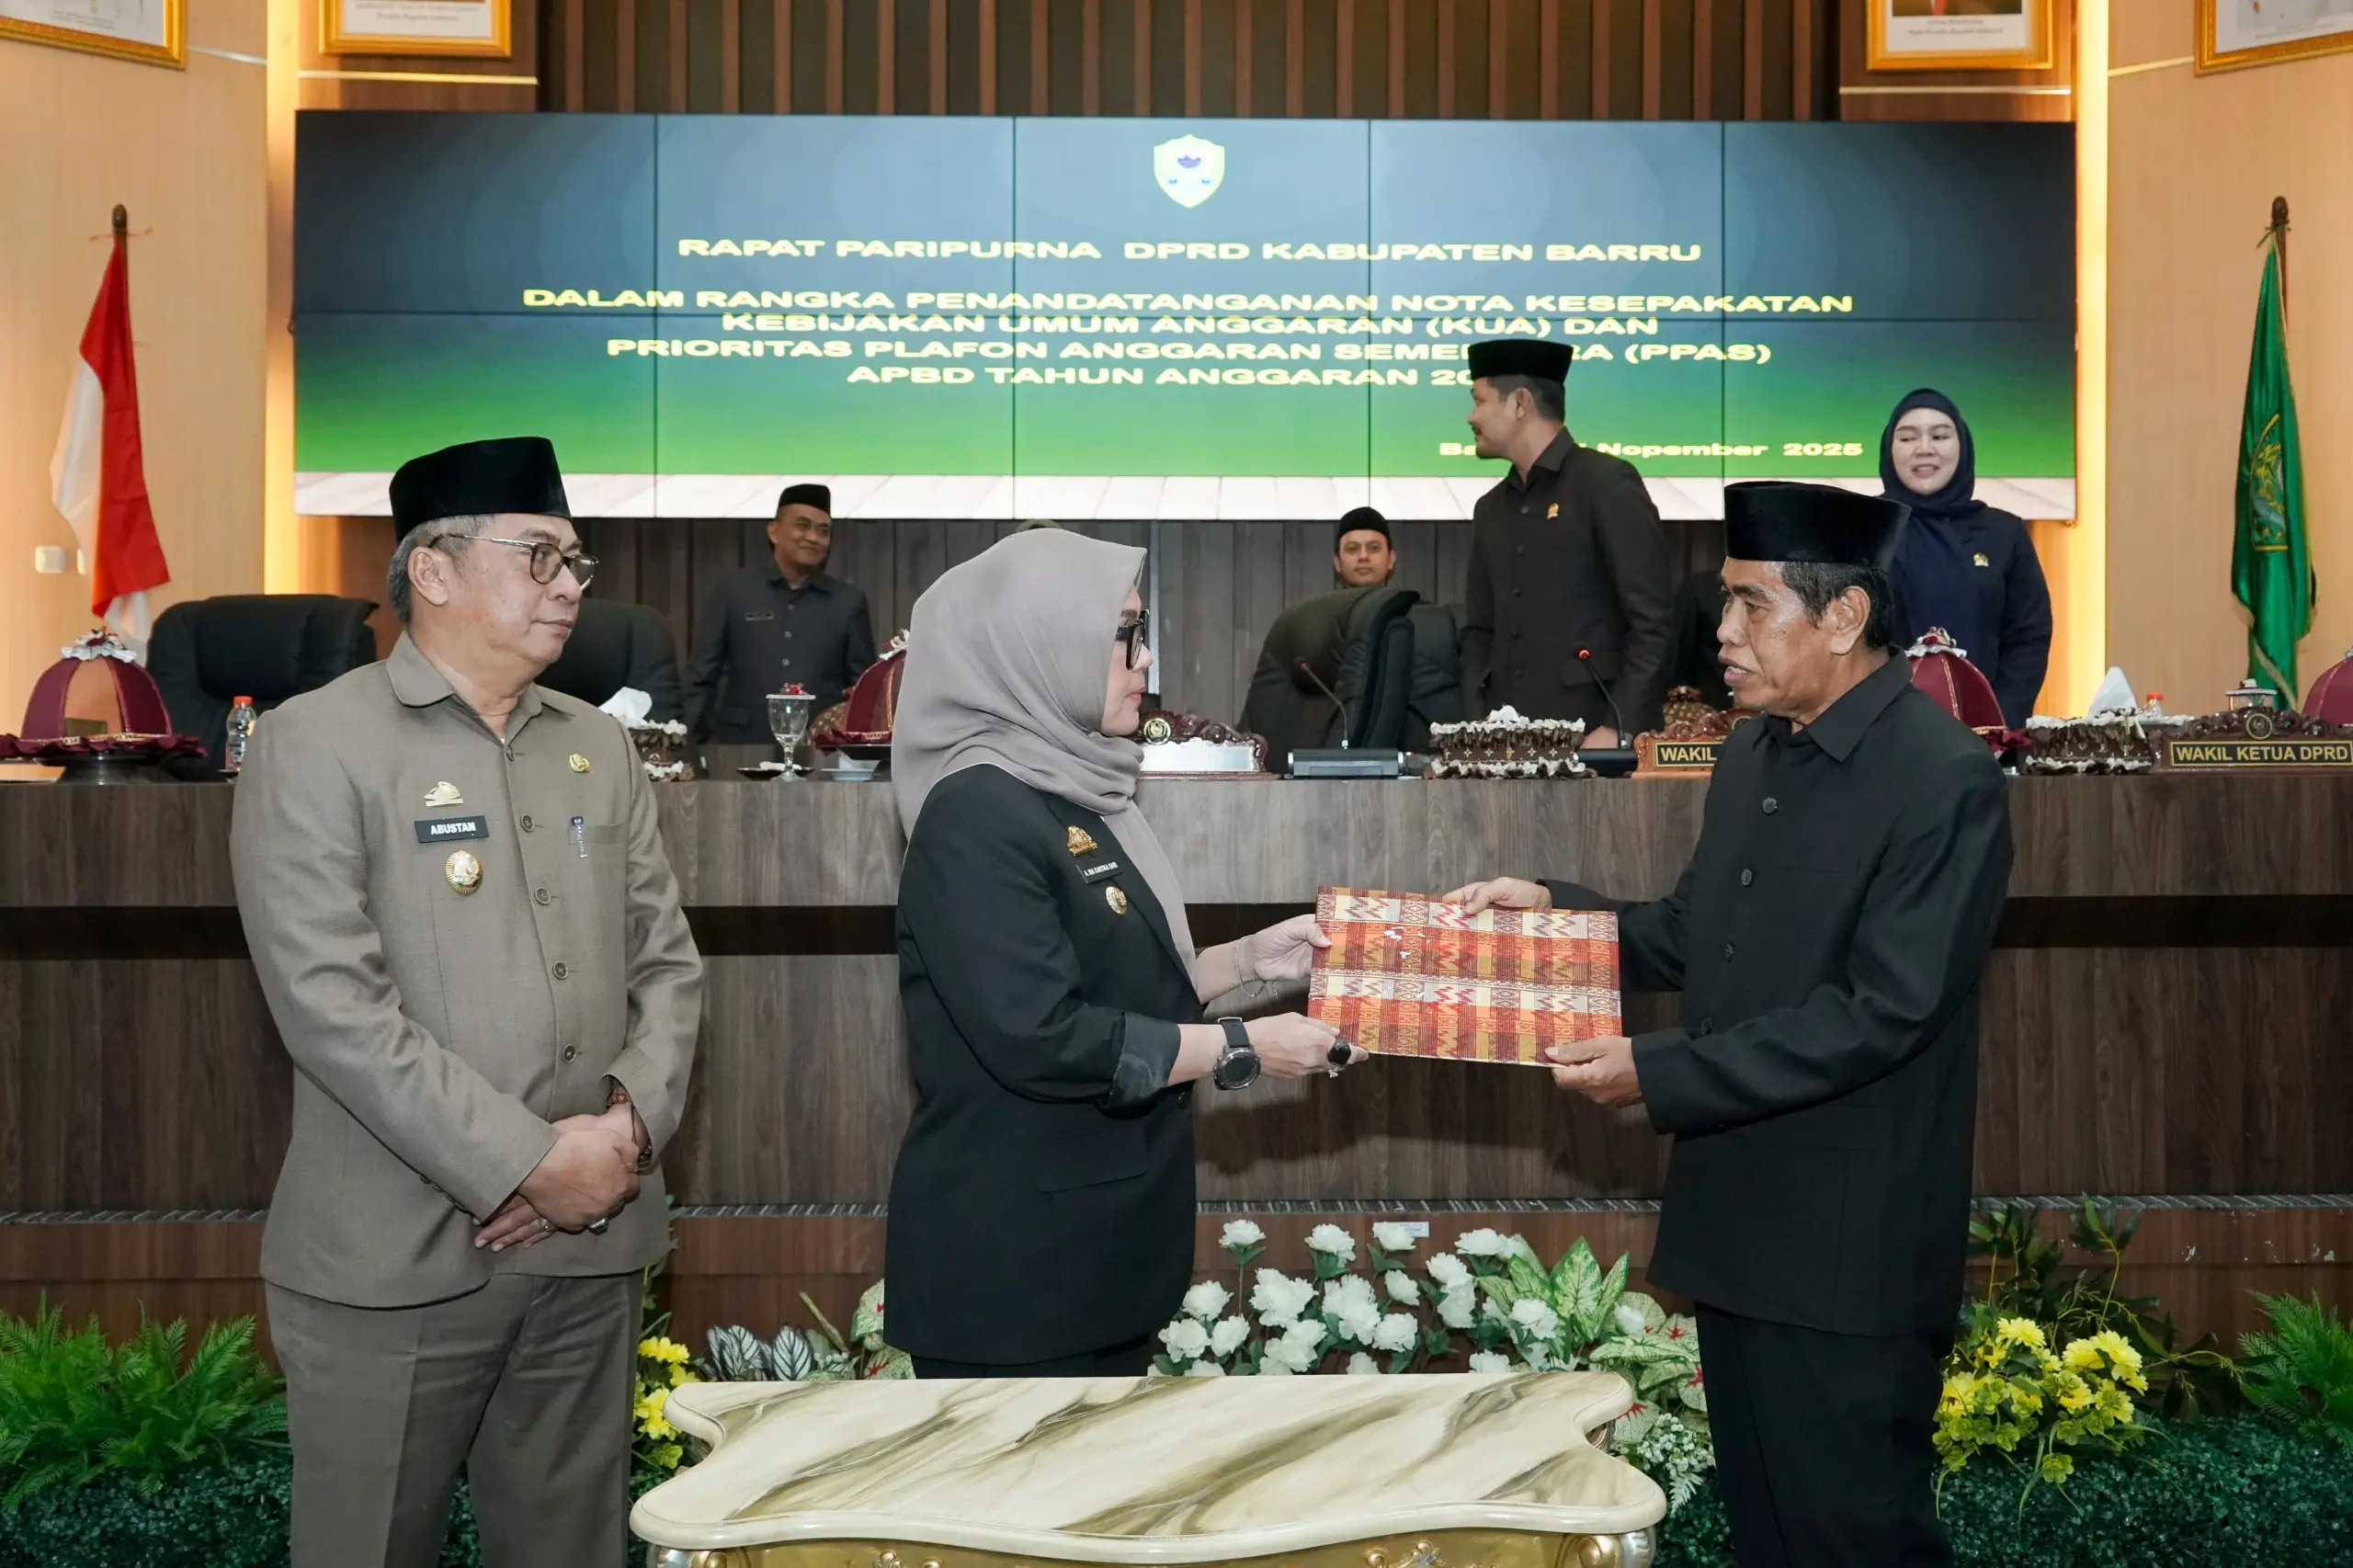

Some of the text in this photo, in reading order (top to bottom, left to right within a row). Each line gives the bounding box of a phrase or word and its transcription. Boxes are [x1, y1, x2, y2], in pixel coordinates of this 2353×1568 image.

[678, 239, 1700, 261] RAPAT PARIPURNA DPRD KABUPATEN BARRU
[523, 290, 1852, 312] DALAM RANGKA PENANDATANGANAN NOTA KESEPAKATAN
[722, 312, 1657, 337] KEBIJAKAN UMUM ANGGARAN (KUA) DAN
[608, 339, 852, 357] PRIORITAS
[864, 341, 1048, 358] PLAFON
[1059, 342, 1321, 360] ANGGARAN
[1624, 344, 1771, 364] (PPAS)
[847, 366, 975, 383] APBD
[984, 367, 1143, 384] TAHUN
[1155, 368, 1418, 385] ANGGARAN
[1597, 442, 1863, 459] Nopember 2025
[1660, 747, 1718, 762] WAKIL
[2176, 745, 2348, 761] WAKIL KETUA DPRD
[430, 821, 476, 836] ABUSTAN
